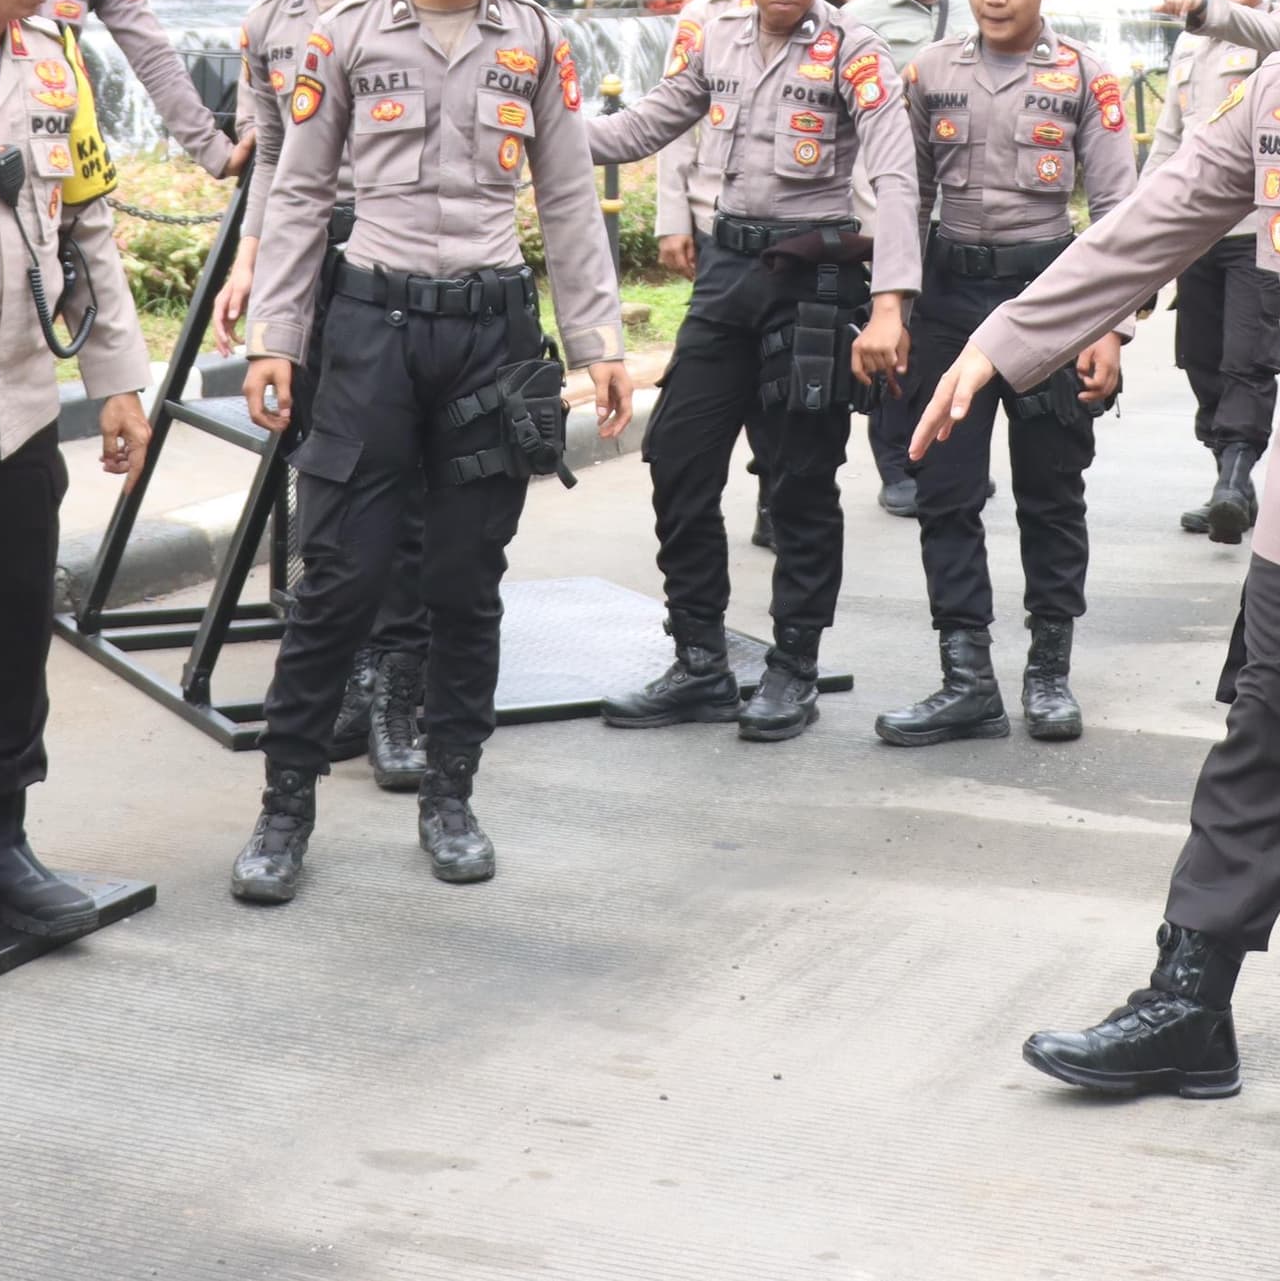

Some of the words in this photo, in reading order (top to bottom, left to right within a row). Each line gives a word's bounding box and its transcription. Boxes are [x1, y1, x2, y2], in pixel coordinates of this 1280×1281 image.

[358, 71, 410, 93] RAFI
[485, 69, 537, 100] POLRI
[782, 83, 838, 107] POLRI
[1024, 94, 1079, 118] POLRI
